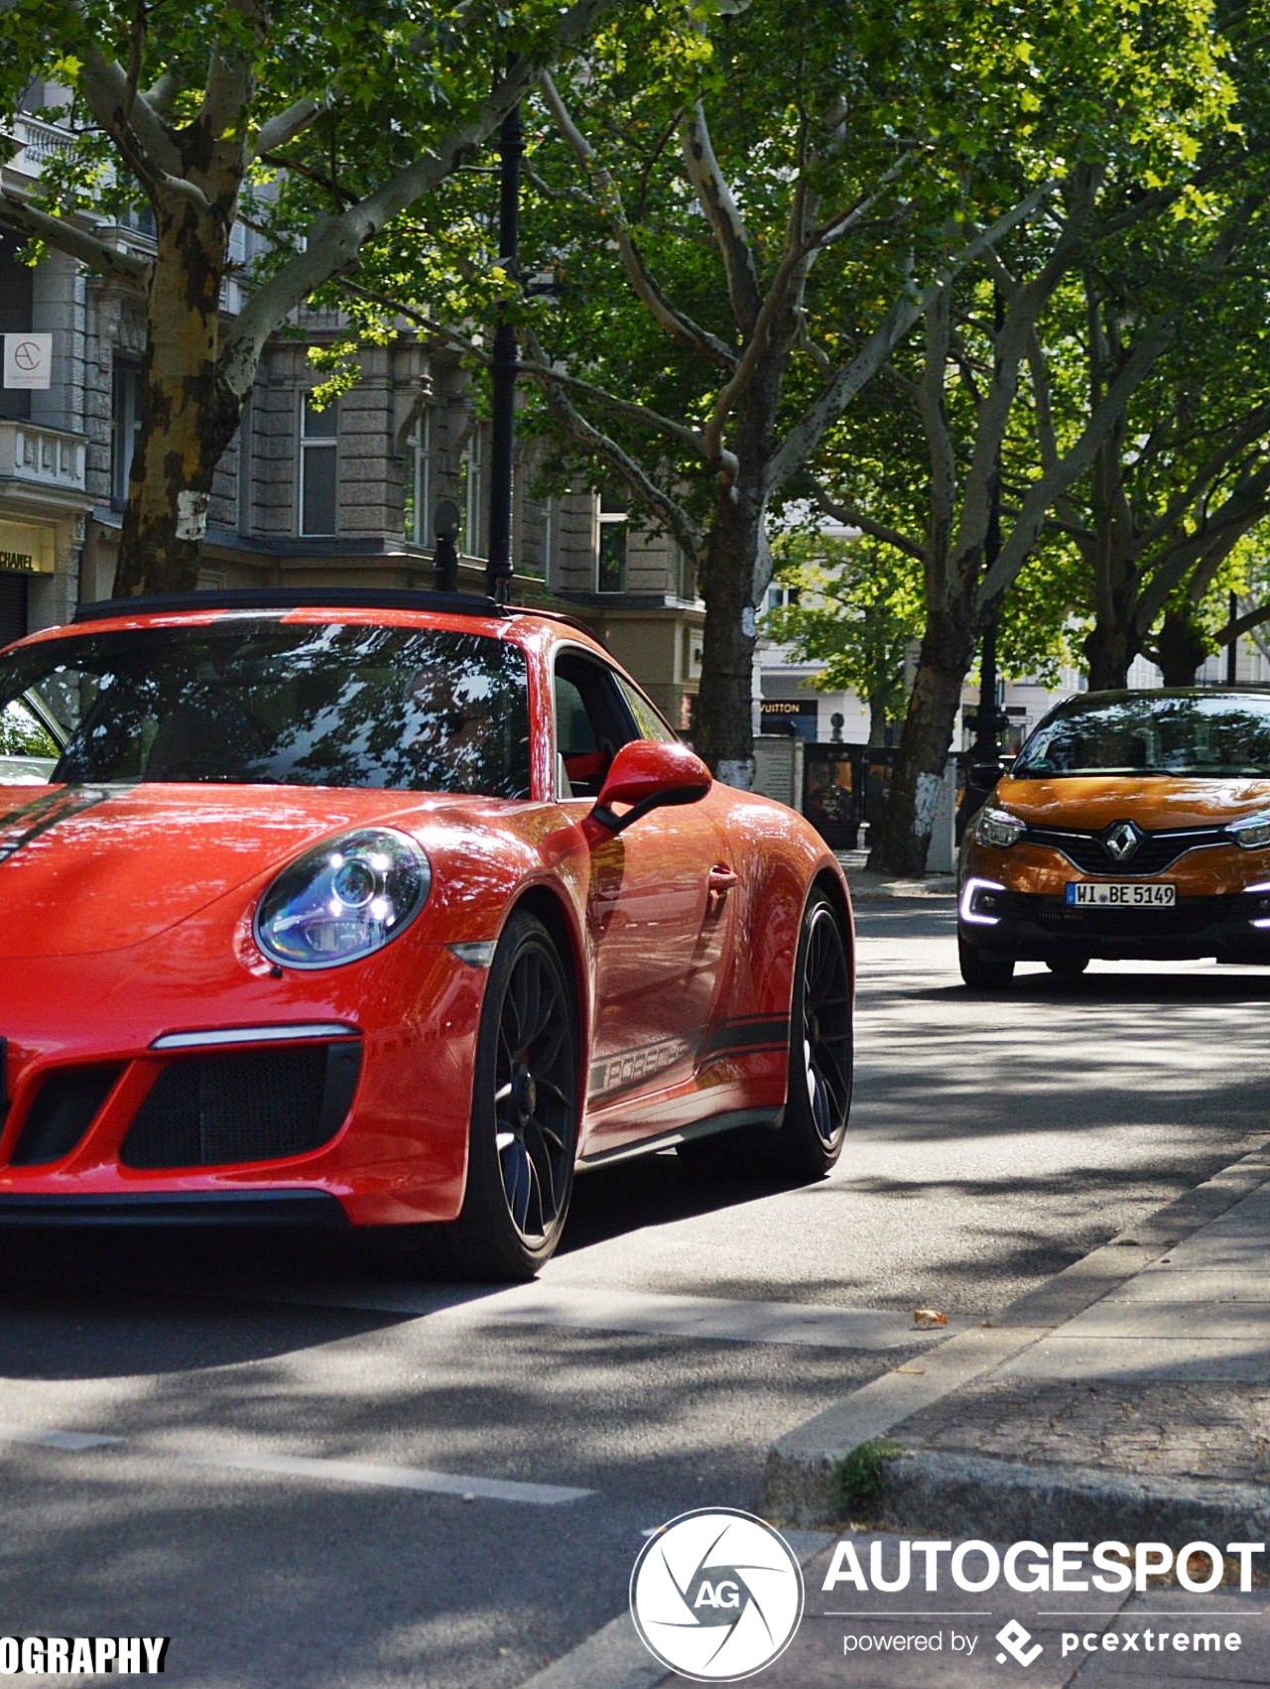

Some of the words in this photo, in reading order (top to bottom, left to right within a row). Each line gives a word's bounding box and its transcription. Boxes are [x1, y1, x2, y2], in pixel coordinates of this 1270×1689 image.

[1077, 886, 1097, 903] WI
[1110, 886, 1130, 903] BE
[1134, 887, 1174, 904] 5149
